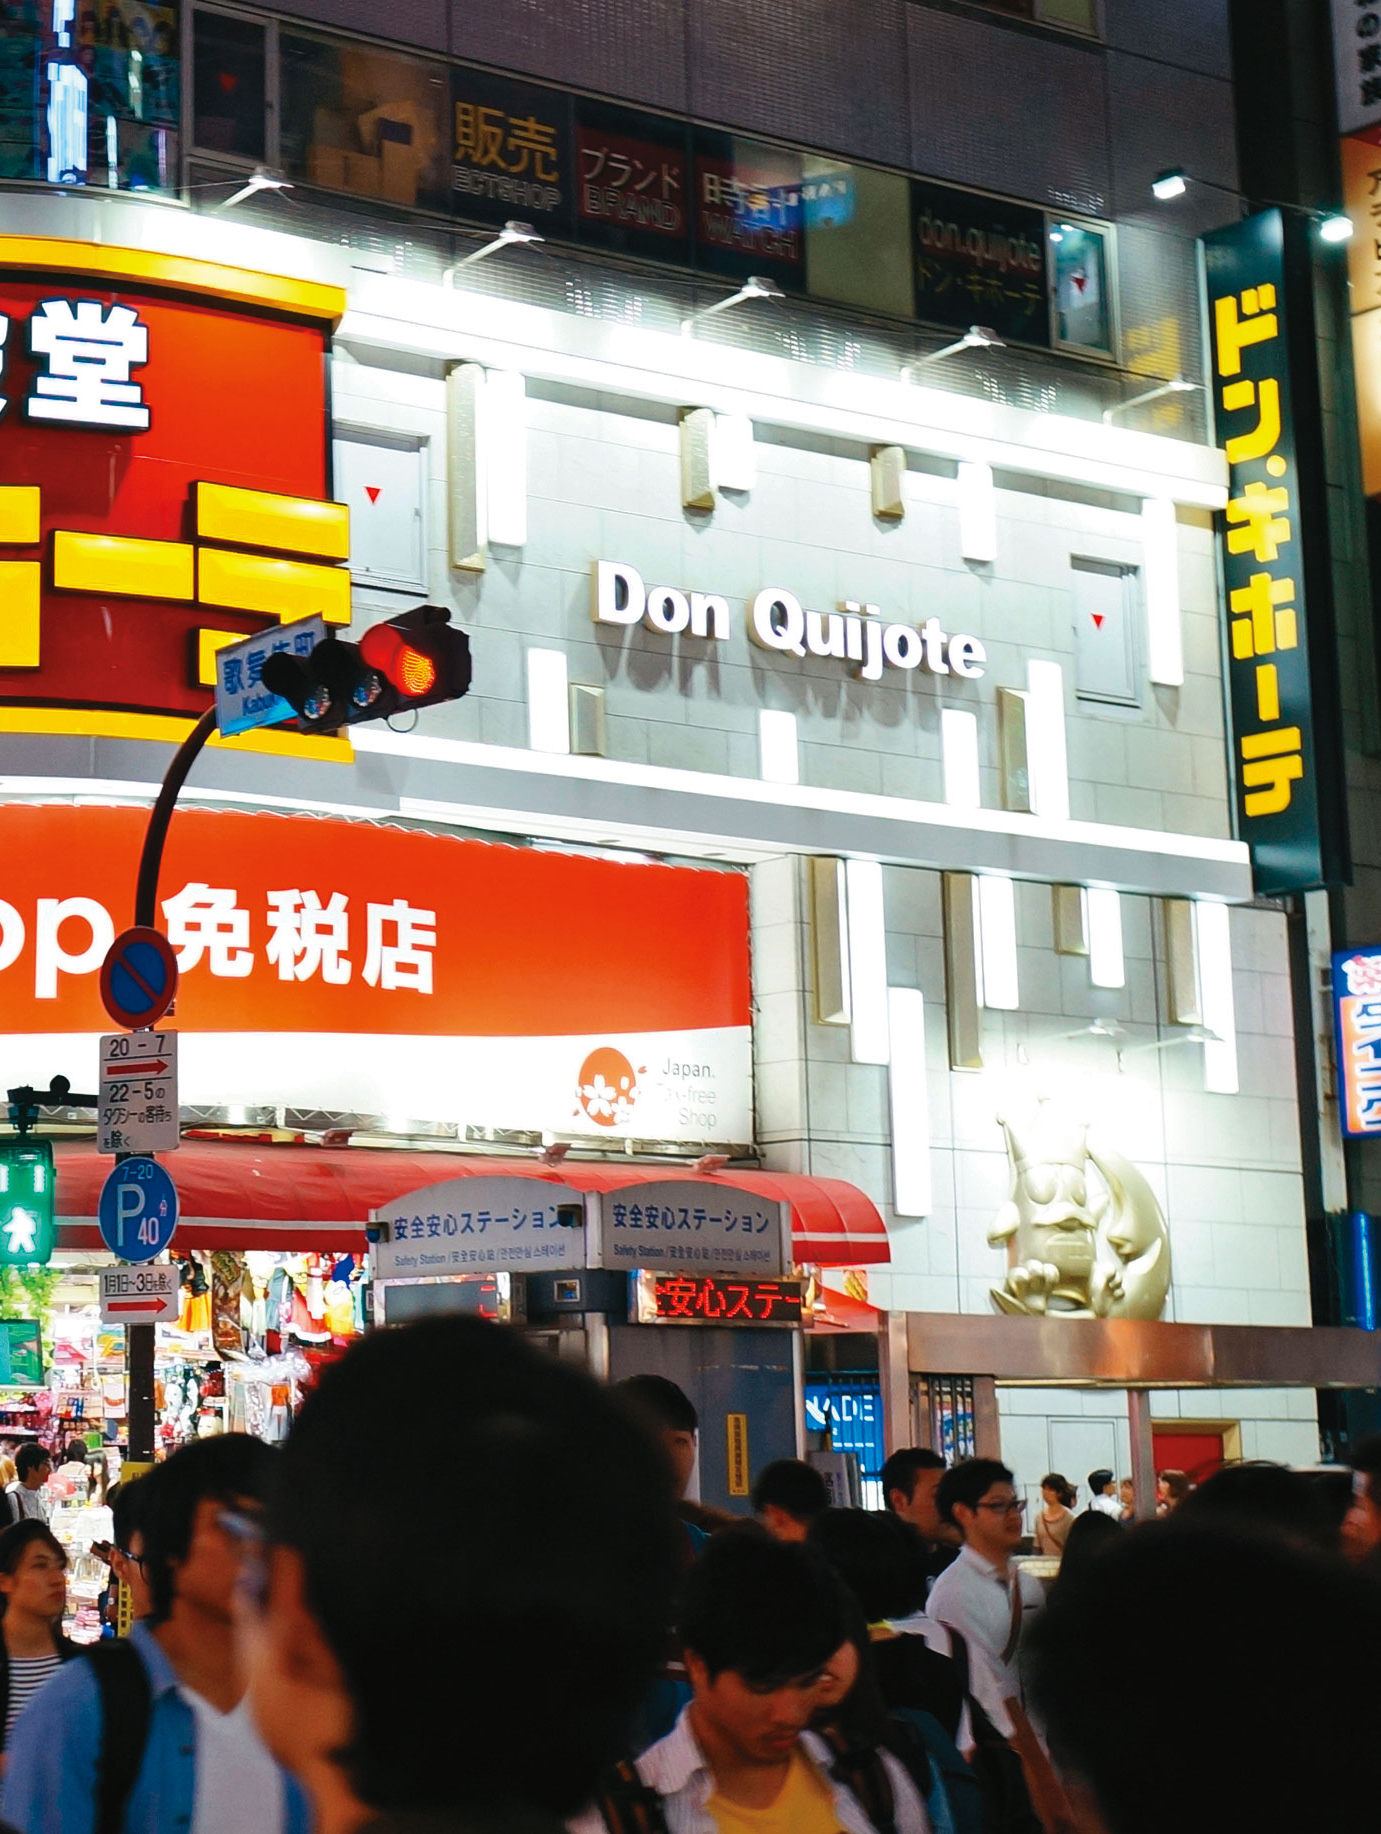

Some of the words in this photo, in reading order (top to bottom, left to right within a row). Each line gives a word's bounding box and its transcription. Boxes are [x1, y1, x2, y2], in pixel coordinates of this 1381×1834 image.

[455, 101, 560, 182] 販売
[582, 147, 680, 199] ブランド
[583, 183, 679, 231] BRAND
[597, 559, 730, 640] Don
[752, 587, 987, 681] Quijote
[161, 883, 437, 995] 免税店
[662, 1057, 716, 1081] Japan.
[655, 1084, 716, 1105] -free
[103, 1104, 173, 1126] タクシーの客待ち
[679, 1107, 717, 1131] Shop
[103, 1130, 131, 1149] を除く
[122, 1164, 154, 1182] 7-20
[117, 1183, 146, 1247] P
[393, 1205, 559, 1241] 安全安心ステーション
[613, 1203, 769, 1233] 安全安心ステーション
[137, 1217, 159, 1245] 40
[395, 1254, 417, 1267] Safety
[420, 1252, 446, 1265] Station
